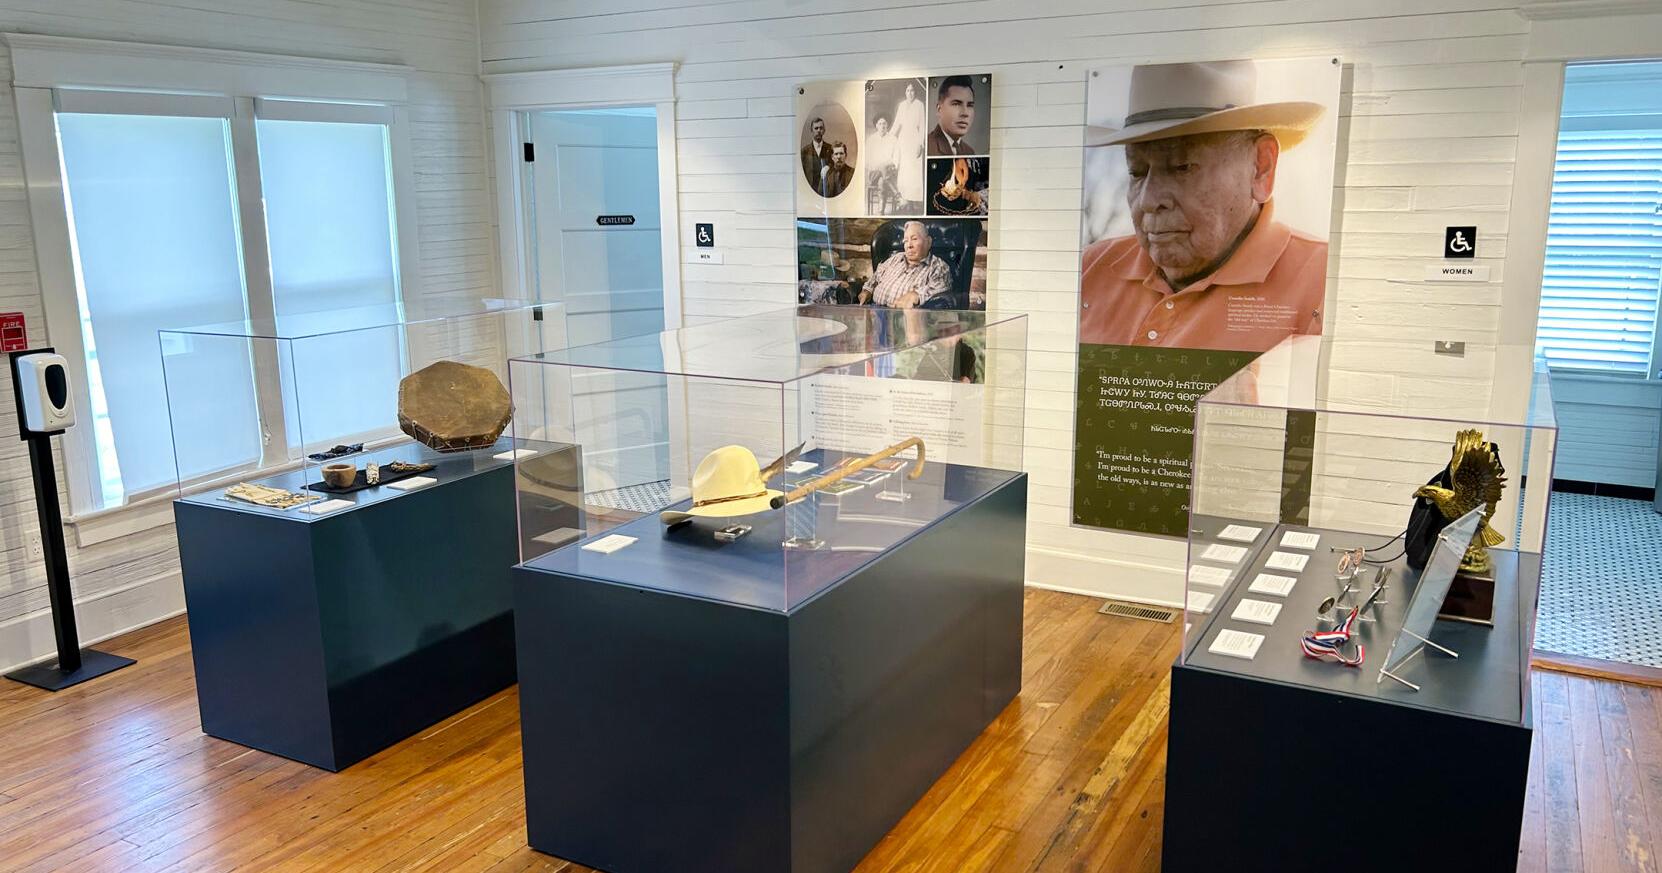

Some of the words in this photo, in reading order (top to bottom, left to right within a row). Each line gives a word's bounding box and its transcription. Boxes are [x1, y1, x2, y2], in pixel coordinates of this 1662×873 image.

[1111, 453, 1132, 462] proud
[1142, 454, 1151, 463] be
[1159, 457, 1188, 467] spiritual
[1110, 464, 1131, 473] proud
[1141, 465, 1150, 474] be
[1157, 467, 1191, 479] Cherokee
[1097, 472, 1109, 481] the
[1109, 474, 1121, 482] old
[1122, 477, 1141, 486] ways,
[1143, 478, 1149, 486] is
